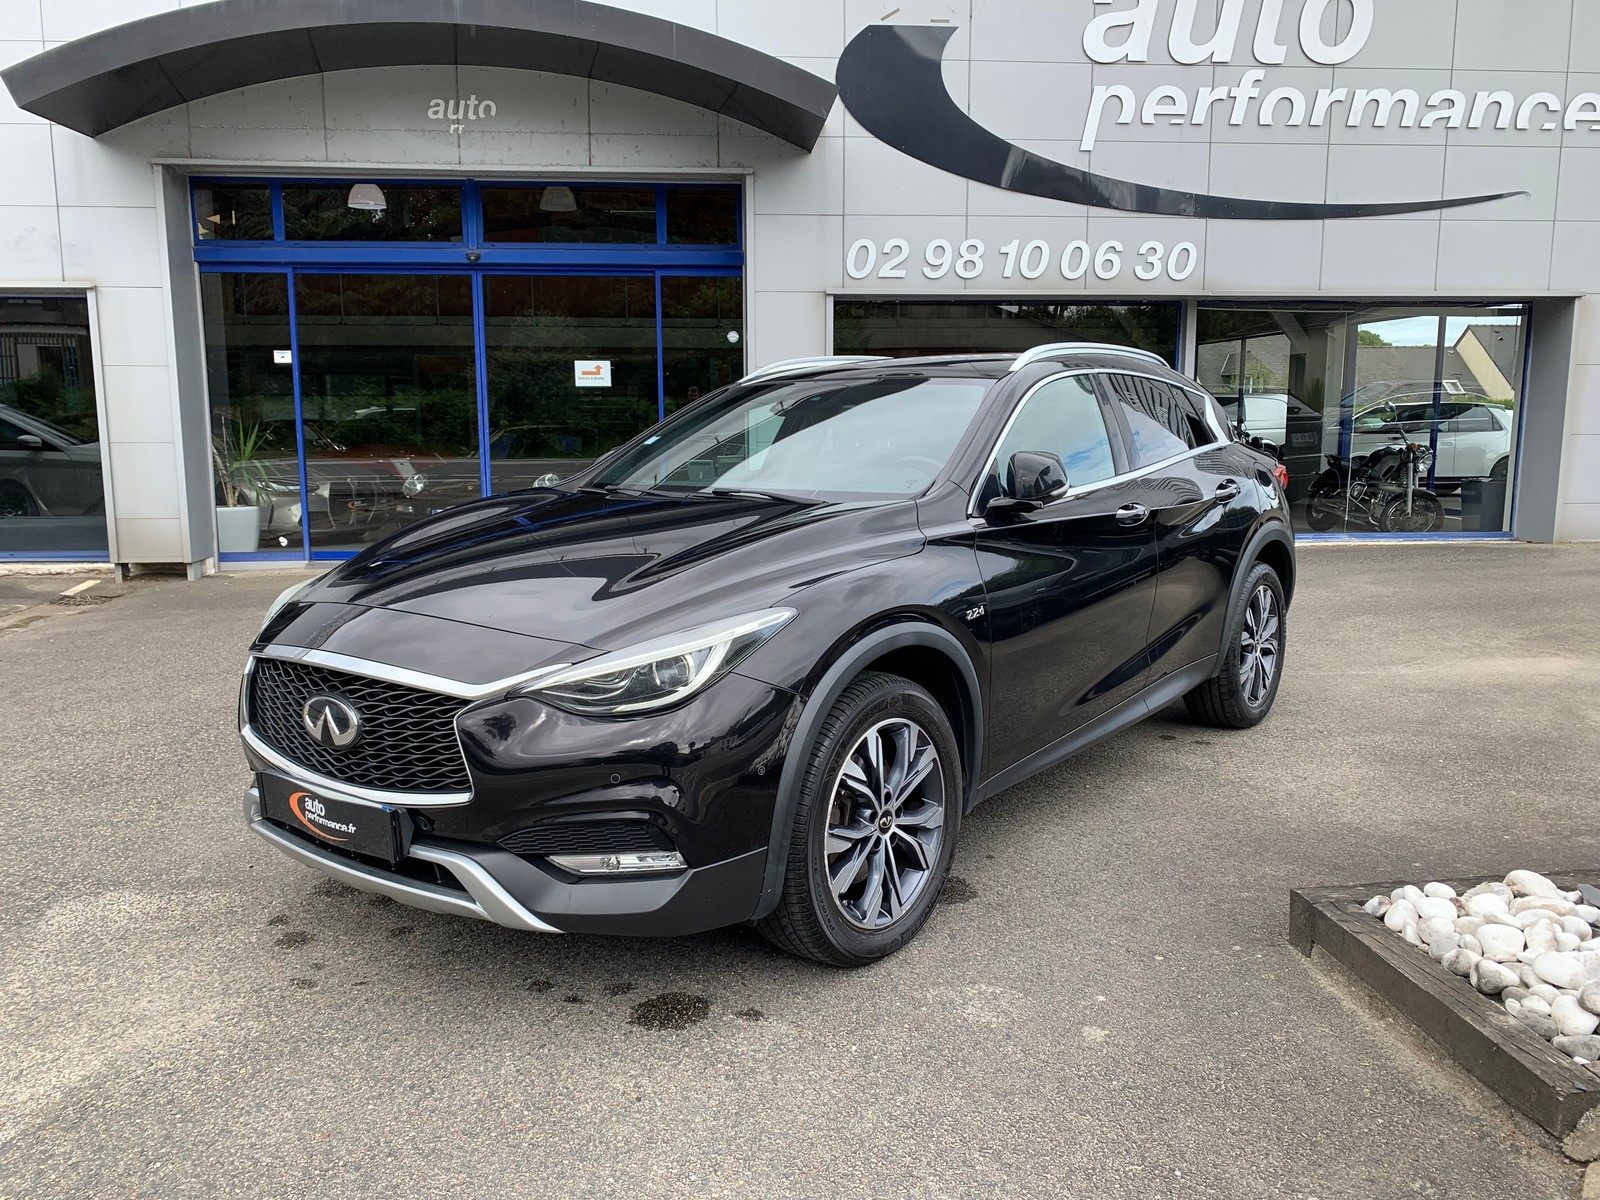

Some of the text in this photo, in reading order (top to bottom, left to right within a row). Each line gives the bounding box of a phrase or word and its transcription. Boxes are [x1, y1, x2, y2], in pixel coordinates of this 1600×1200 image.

[1082, 0, 1375, 65] auto
[427, 94, 497, 120] auto
[1079, 69, 1600, 151] performance
[846, 238, 1198, 281] 02 98 10 06 30
[304, 797, 326, 817] auto
